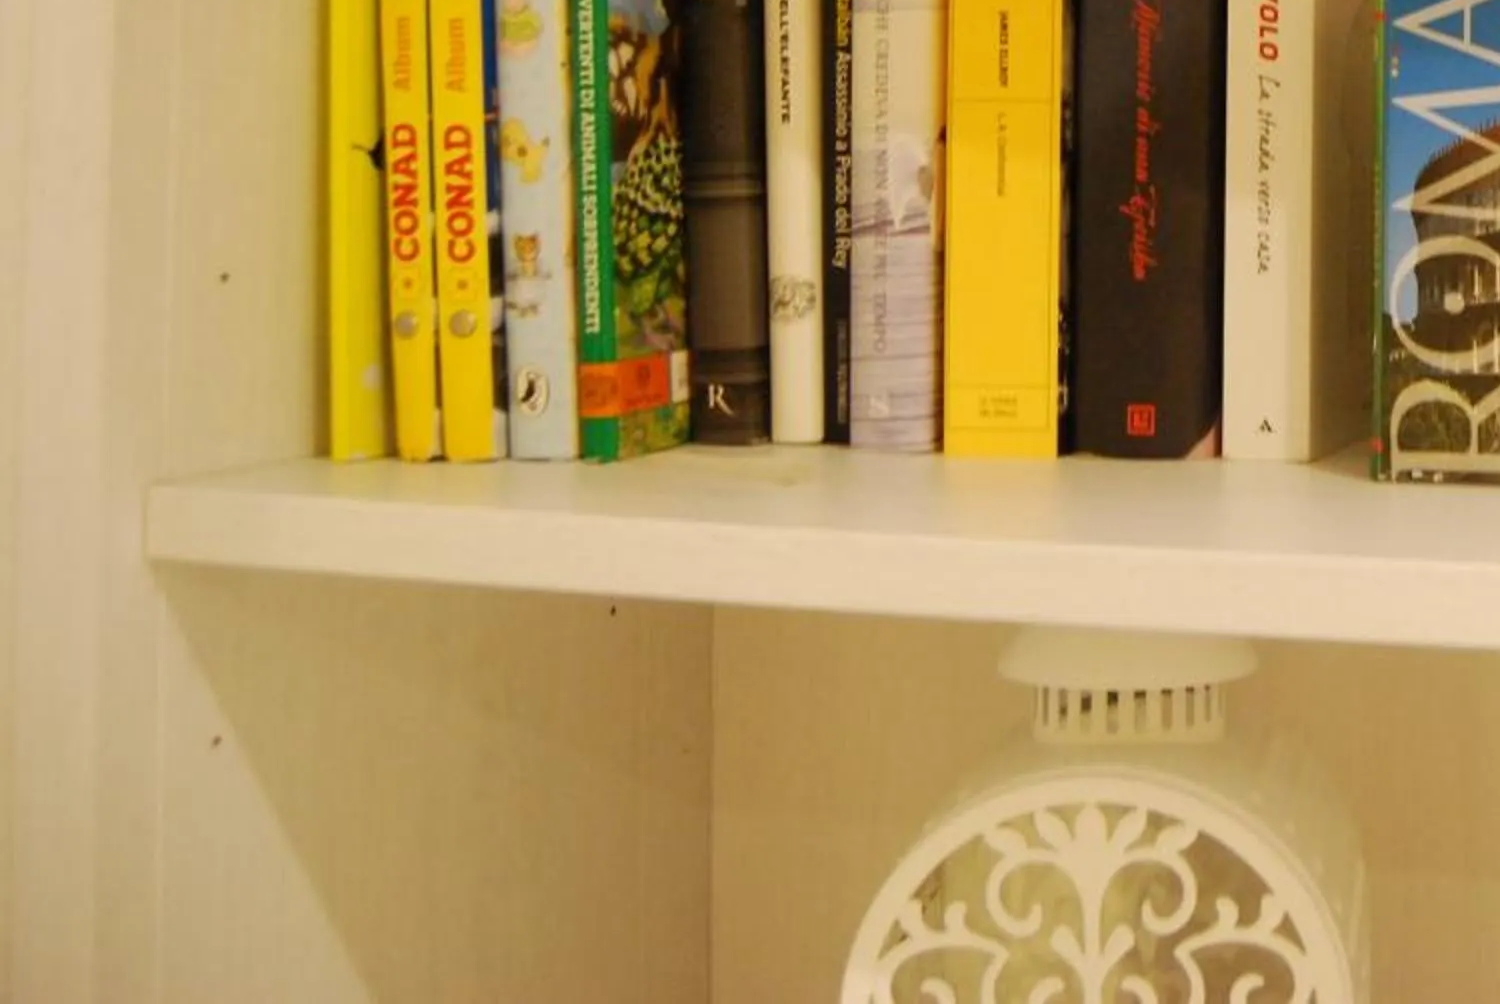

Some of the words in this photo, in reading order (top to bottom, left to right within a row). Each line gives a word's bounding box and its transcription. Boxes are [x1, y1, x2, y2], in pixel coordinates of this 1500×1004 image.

[393, 16, 412, 91] Album
[444, 17, 467, 93] Album
[579, 88, 596, 108] DI
[834, 49, 852, 138] Assassinio
[1258, 74, 1282, 102] La
[580, 112, 598, 190] ANIMALI
[834, 139, 848, 151] a
[1256, 108, 1277, 174] strada
[391, 123, 420, 263] CONAD
[443, 123, 476, 265] CONAD
[833, 153, 851, 204] Prado
[1256, 179, 1272, 226] verso
[834, 206, 851, 234] del
[831, 236, 850, 269] Rey
[1256, 230, 1271, 276] casa
